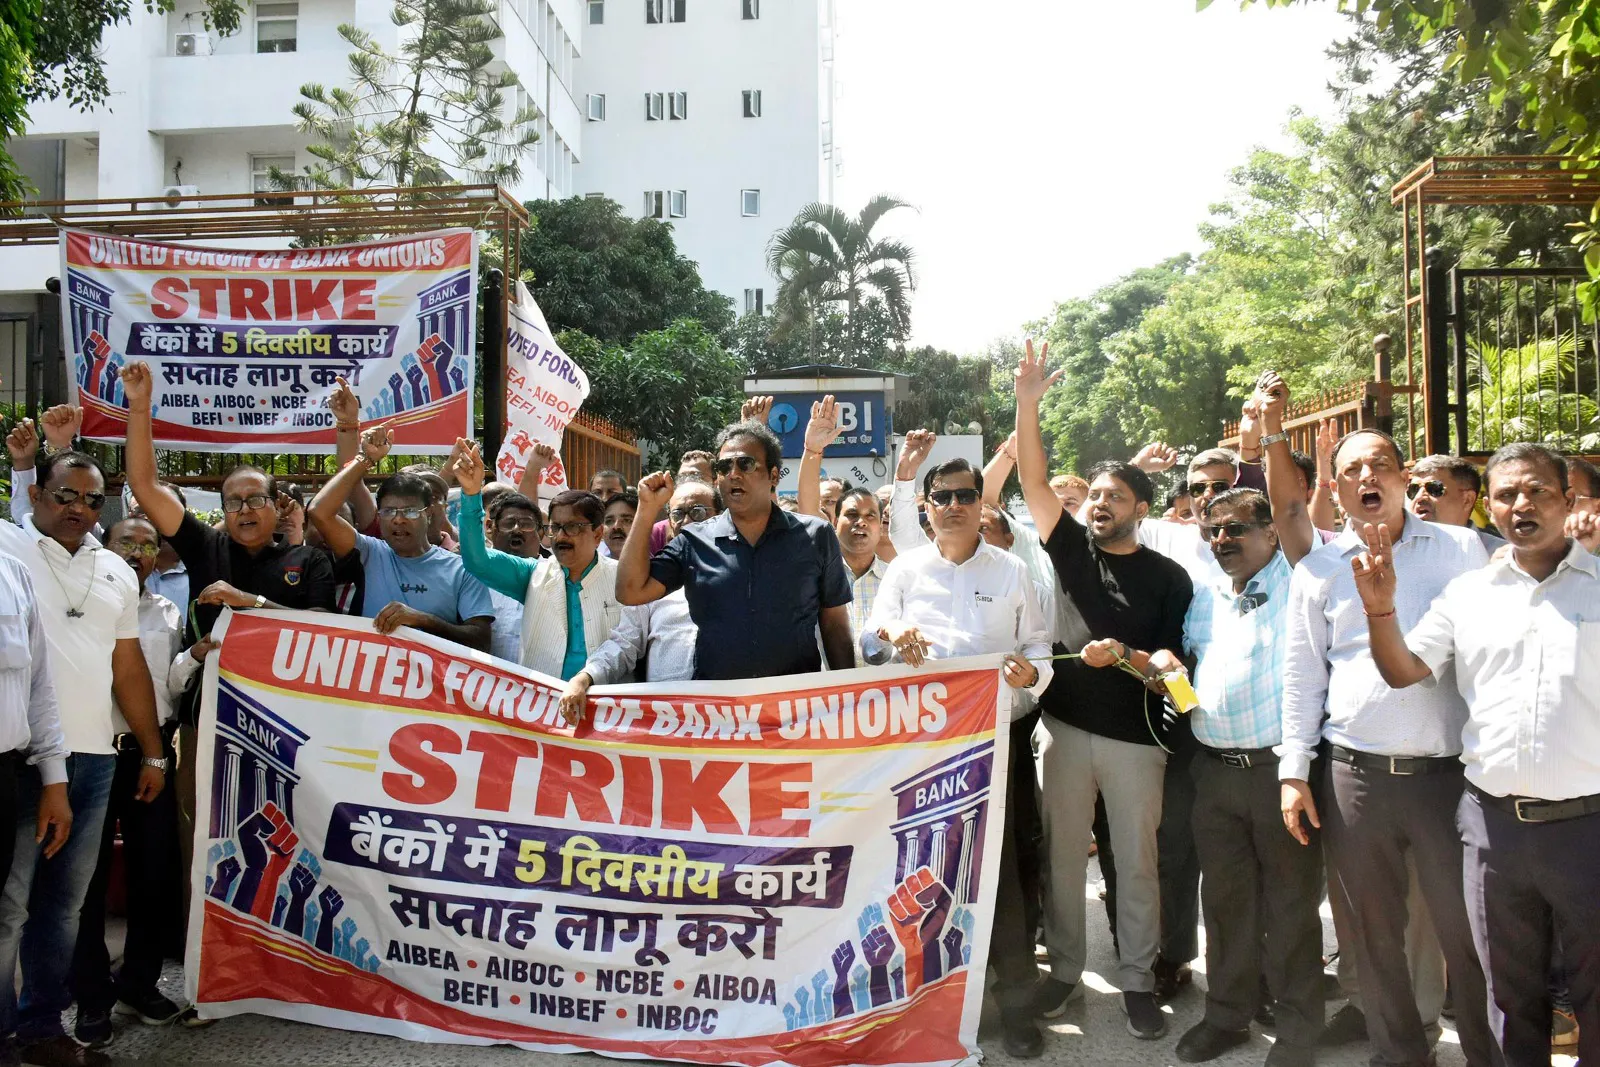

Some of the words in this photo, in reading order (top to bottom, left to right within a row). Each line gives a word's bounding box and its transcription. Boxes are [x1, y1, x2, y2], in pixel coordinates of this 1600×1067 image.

[89, 236, 168, 265] UNITED
[257, 251, 290, 269] OF
[291, 250, 355, 269] BANK
[357, 238, 446, 267] UNIONS
[76, 281, 102, 303] BANK
[150, 277, 377, 321] STRIKE
[428, 284, 458, 306] BANK
[140, 322, 191, 353] बैंकों
[196, 327, 216, 354] में
[221, 332, 238, 354] 5
[245, 327, 332, 356] दिवसीय
[337, 327, 389, 355] कार्य
[507, 327, 539, 360] NITED
[161, 362, 240, 388] सप्ताह
[246, 364, 309, 393] लागू
[161, 393, 200, 408] AIBEA
[213, 394, 255, 408] AIBOC
[272, 395, 307, 408] NCBE
[810, 401, 872, 431] BI
[192, 412, 222, 425] BEFI
[238, 412, 279, 426] INBEF
[292, 412, 333, 426] INBOC
[850, 466, 869, 485] POST
[272, 628, 434, 700] UNITED
[593, 697, 644, 733] OF
[648, 697, 764, 741] BANK
[778, 682, 948, 741] UNIONS
[236, 707, 281, 756] BANK
[381, 723, 813, 838] STRIKE
[915, 769, 970, 809] BANK
[349, 811, 456, 873] बैंकों
[464, 827, 507, 879] में
[514, 840, 547, 883] 5
[560, 835, 725, 900] दिवसीय
[733, 852, 832, 900] कार्य
[387, 883, 542, 953] सप्ताह
[555, 901, 671, 967] लागू
[675, 905, 783, 961] करो
[385, 939, 460, 972] AIBEA
[485, 957, 564, 988] AIBOC
[595, 969, 664, 997] NCBE
[693, 973, 777, 1005] AIBOA
[443, 978, 500, 1009] BEFI
[530, 994, 606, 1023] INBEF
[636, 1003, 719, 1034] INBOC
